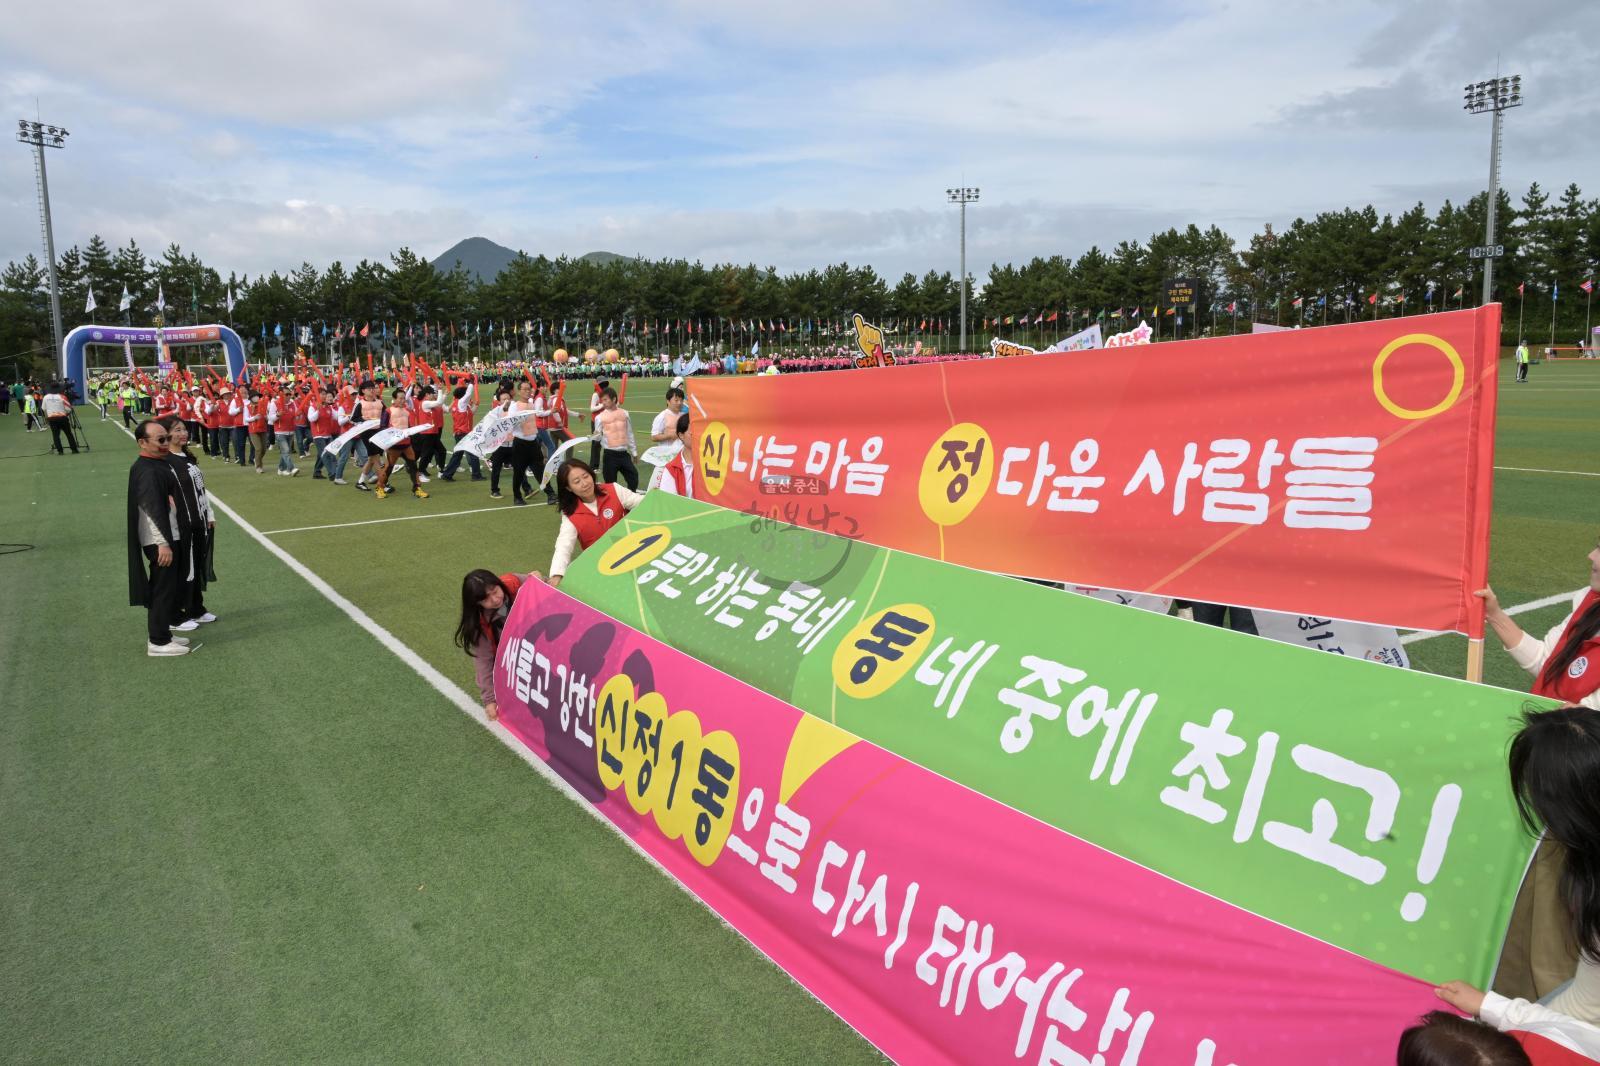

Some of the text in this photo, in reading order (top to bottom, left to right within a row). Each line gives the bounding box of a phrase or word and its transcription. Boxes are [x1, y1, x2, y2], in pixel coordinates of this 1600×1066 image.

[703, 432, 1379, 530] 신나는 마음 정다운 사람들
[501, 636, 551, 710] 새롭고
[556, 664, 597, 748] 강한
[812, 840, 920, 969] 다시
[997, 655, 1158, 786] 중에
[1160, 708, 1463, 922] 최고!
